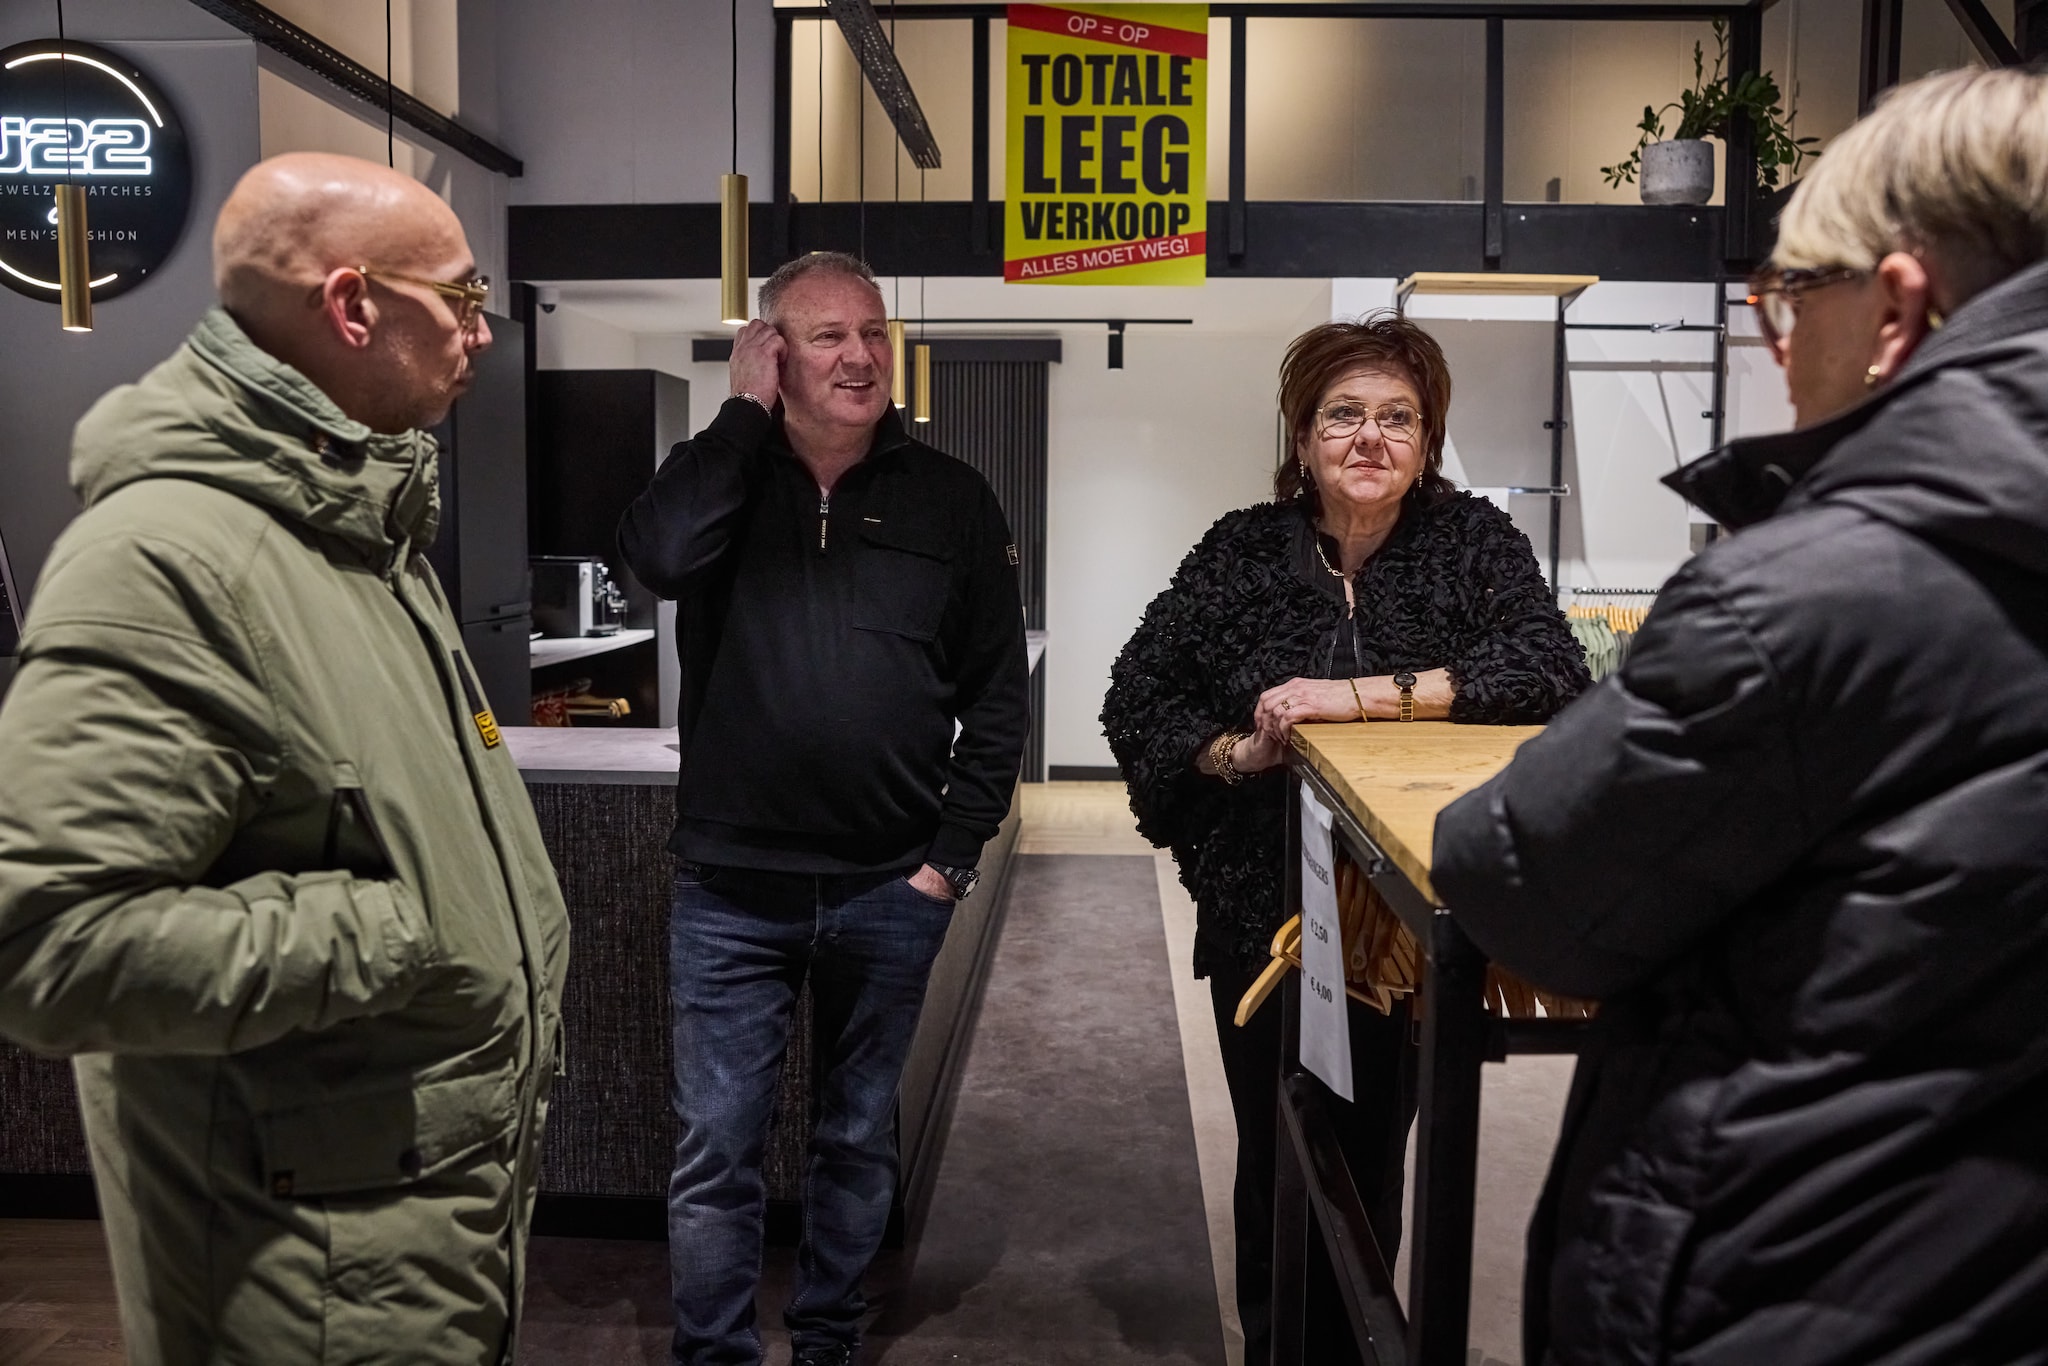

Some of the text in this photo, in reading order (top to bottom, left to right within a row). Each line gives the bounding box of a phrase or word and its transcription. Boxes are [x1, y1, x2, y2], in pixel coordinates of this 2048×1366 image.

[1067, 15, 1149, 43] OP = OP
[1021, 54, 1193, 107] TOTALE
[1024, 114, 1190, 196] LEEG
[83, 185, 153, 196] ATCHES
[6, 229, 138, 241] MEN'S SHION
[1020, 201, 1190, 242] VERKOOP
[1020, 238, 1190, 277] ALLES MOET WEG!
